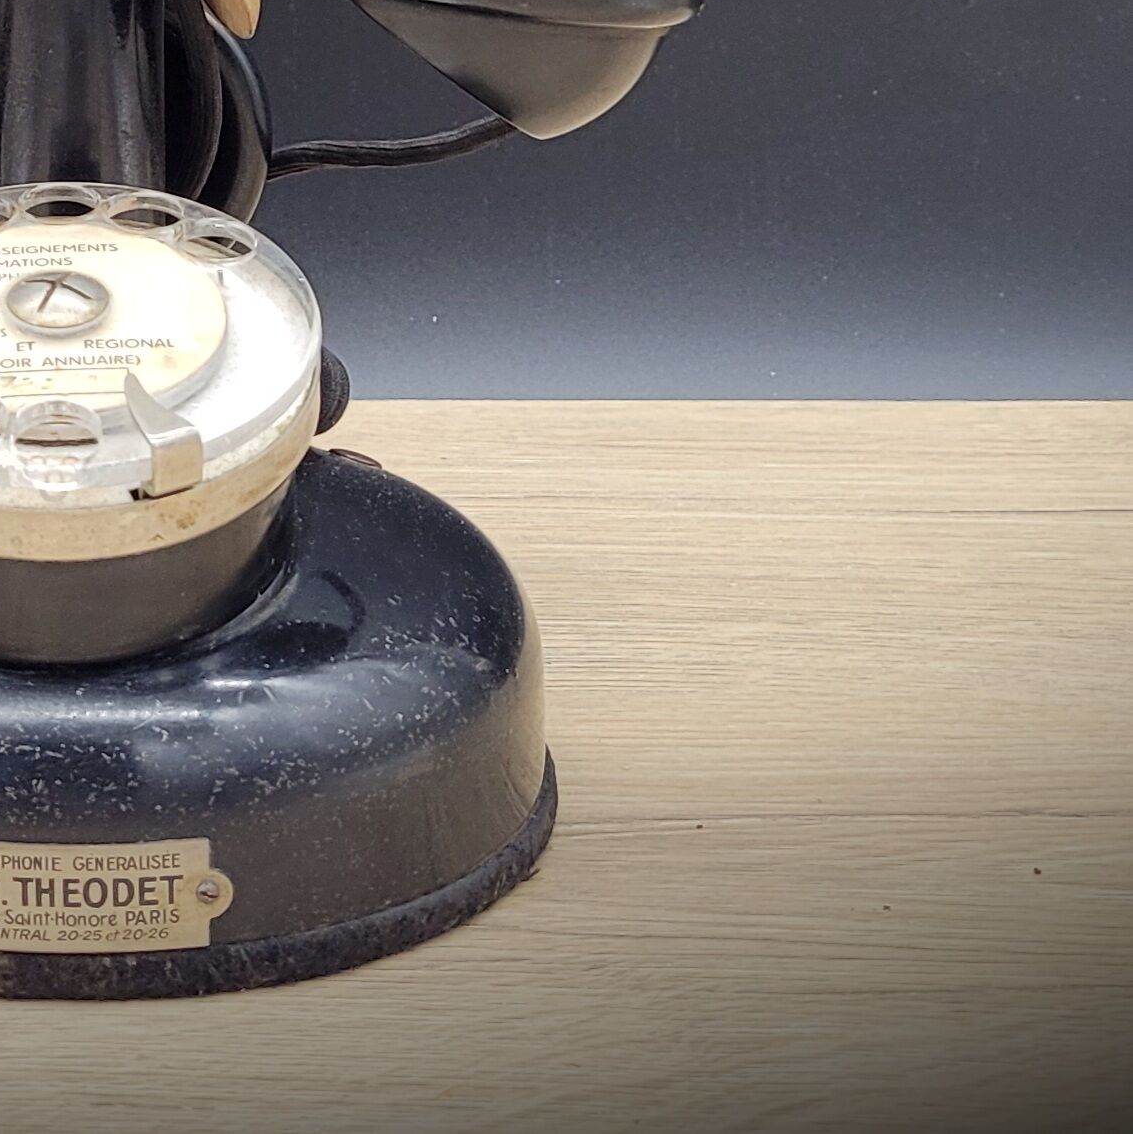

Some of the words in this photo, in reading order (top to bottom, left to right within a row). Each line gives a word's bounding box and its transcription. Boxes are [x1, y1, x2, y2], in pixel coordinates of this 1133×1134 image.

[16, 341, 35, 352] ET
[83, 338, 175, 350] REGIONAL
[41, 354, 141, 367] ANNUAIRE)
[12, 874, 184, 908] THEODET
[125, 908, 180, 926] PARIS
[105, 929, 119, 942] et
